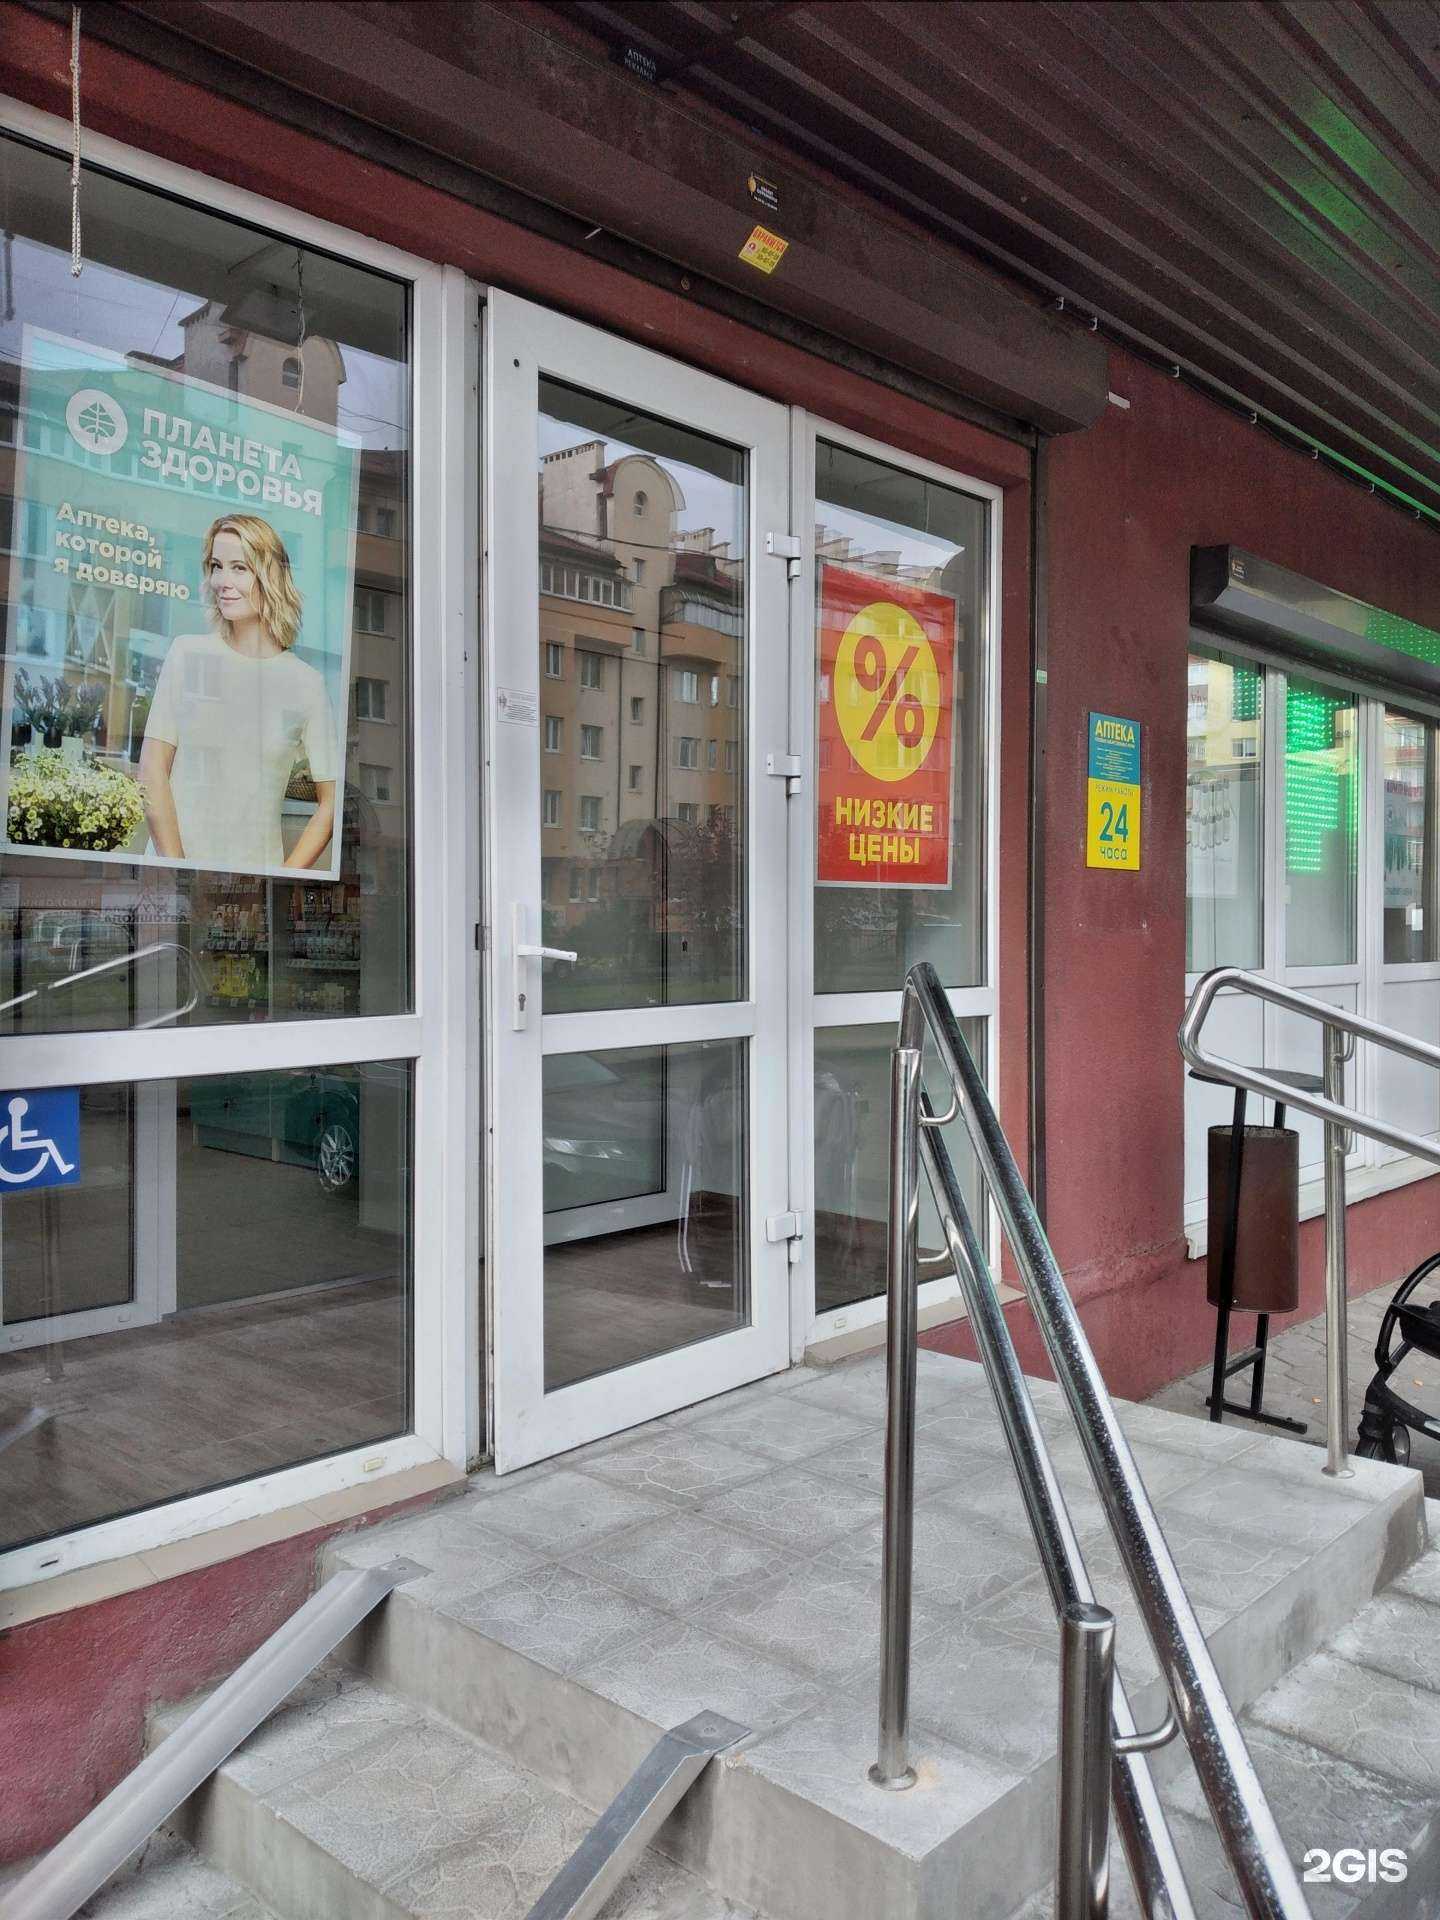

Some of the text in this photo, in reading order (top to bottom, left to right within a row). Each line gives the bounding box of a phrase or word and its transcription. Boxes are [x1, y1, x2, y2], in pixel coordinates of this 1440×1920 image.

[143, 408, 302, 481] ПЛАНЕТА
[140, 440, 323, 517] ЗДОРОВЬЯ
[57, 502, 156, 547] Аптека,
[55, 531, 163, 569] которой
[54, 558, 190, 600] я доверяю
[1095, 719, 1135, 743] АПТЕКА
[834, 797, 934, 832] НИЗКИЕ
[1099, 802, 1129, 843] 24
[849, 833, 921, 866] ЦЕНЫ
